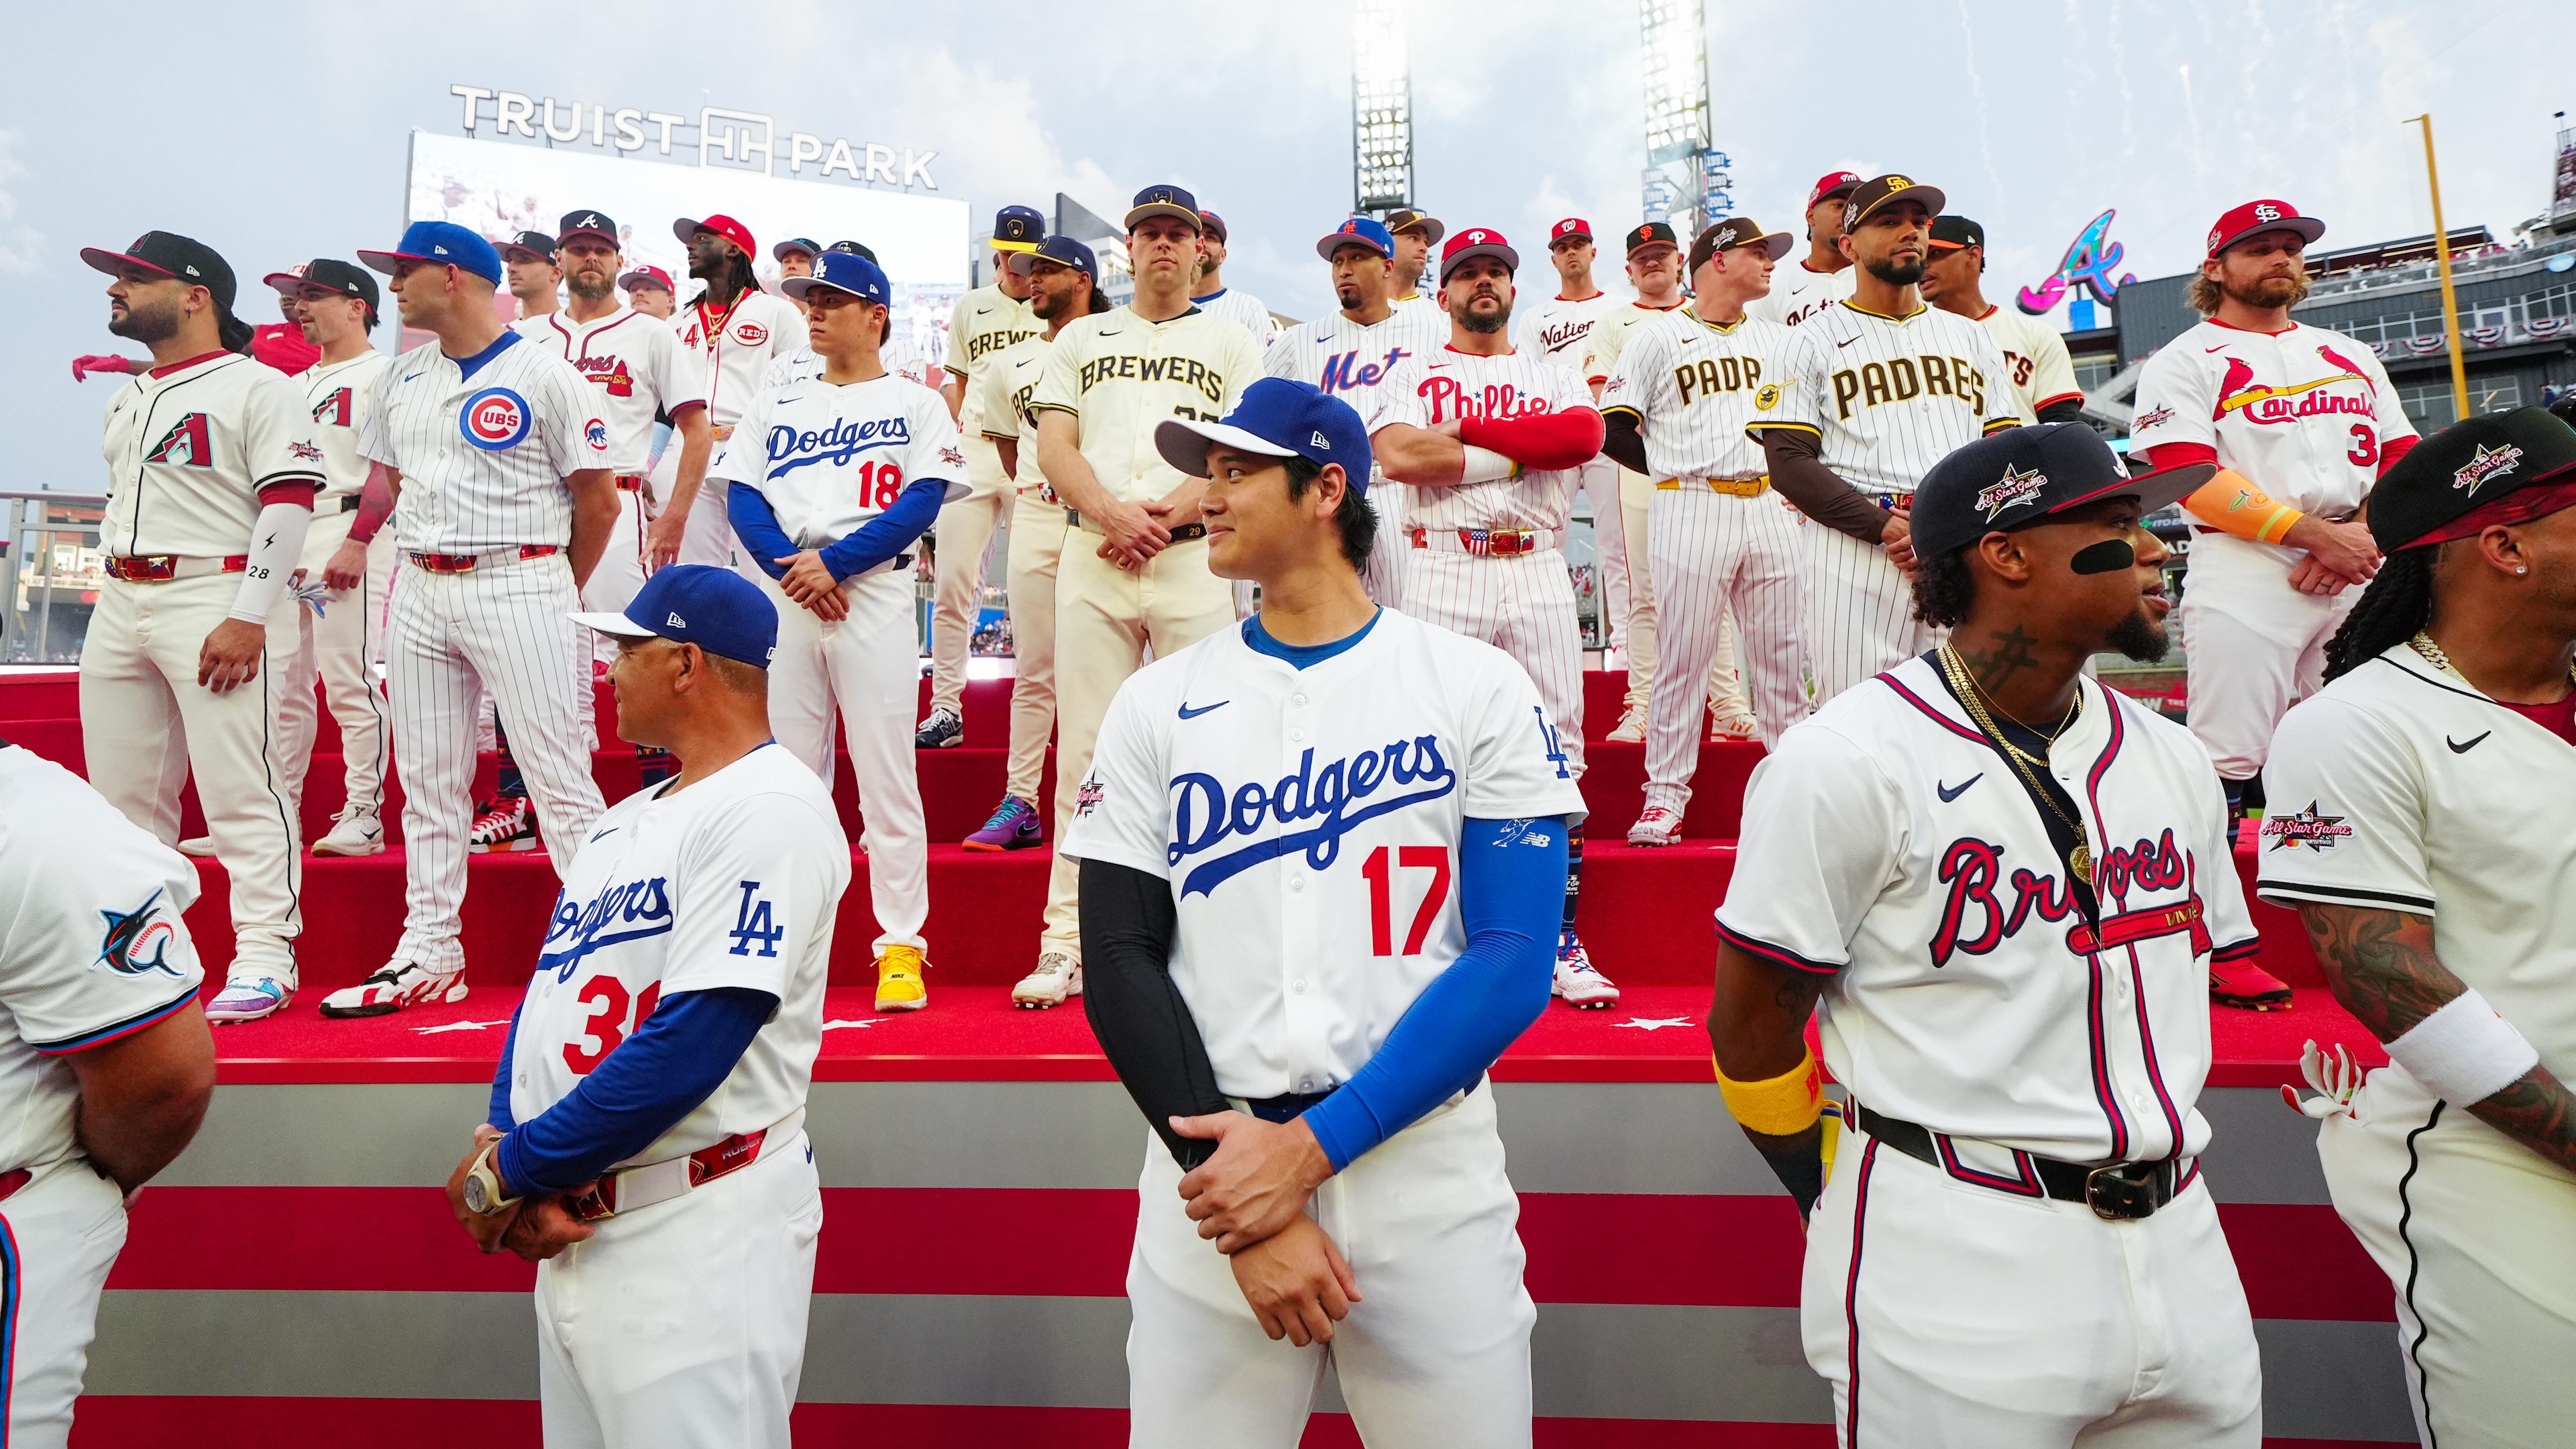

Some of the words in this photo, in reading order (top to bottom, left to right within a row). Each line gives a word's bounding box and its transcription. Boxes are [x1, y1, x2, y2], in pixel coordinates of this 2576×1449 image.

[450, 84, 686, 155] TRUIST
[790, 132, 940, 191] PARK
[739, 327, 767, 339] REDS
[969, 330, 1038, 363] BREW
[574, 355, 616, 371] ves
[1079, 356, 1223, 405] BREWERS
[1417, 376, 1552, 424] Phillie
[1831, 355, 1986, 423] PADRES
[2242, 390, 2378, 425] Cardinals
[766, 417, 910, 470] Dodgers
[2348, 423, 2378, 467] 3
[859, 461, 902, 511] 18
[1975, 493, 1995, 511] All
[1995, 486, 2017, 501] Star
[2017, 475, 2047, 492] Game
[2453, 472, 2471, 488] All
[2471, 460, 2492, 477] Star
[1189, 527, 1200, 536] 29
[249, 566, 270, 579] 28
[1168, 734, 1456, 879] Dodgers
[2261, 821, 2284, 836] All
[2284, 820, 2311, 835] Star
[2312, 821, 2352, 836] Game
[729, 880, 784, 958] LA
[1361, 845, 1452, 957] 17
